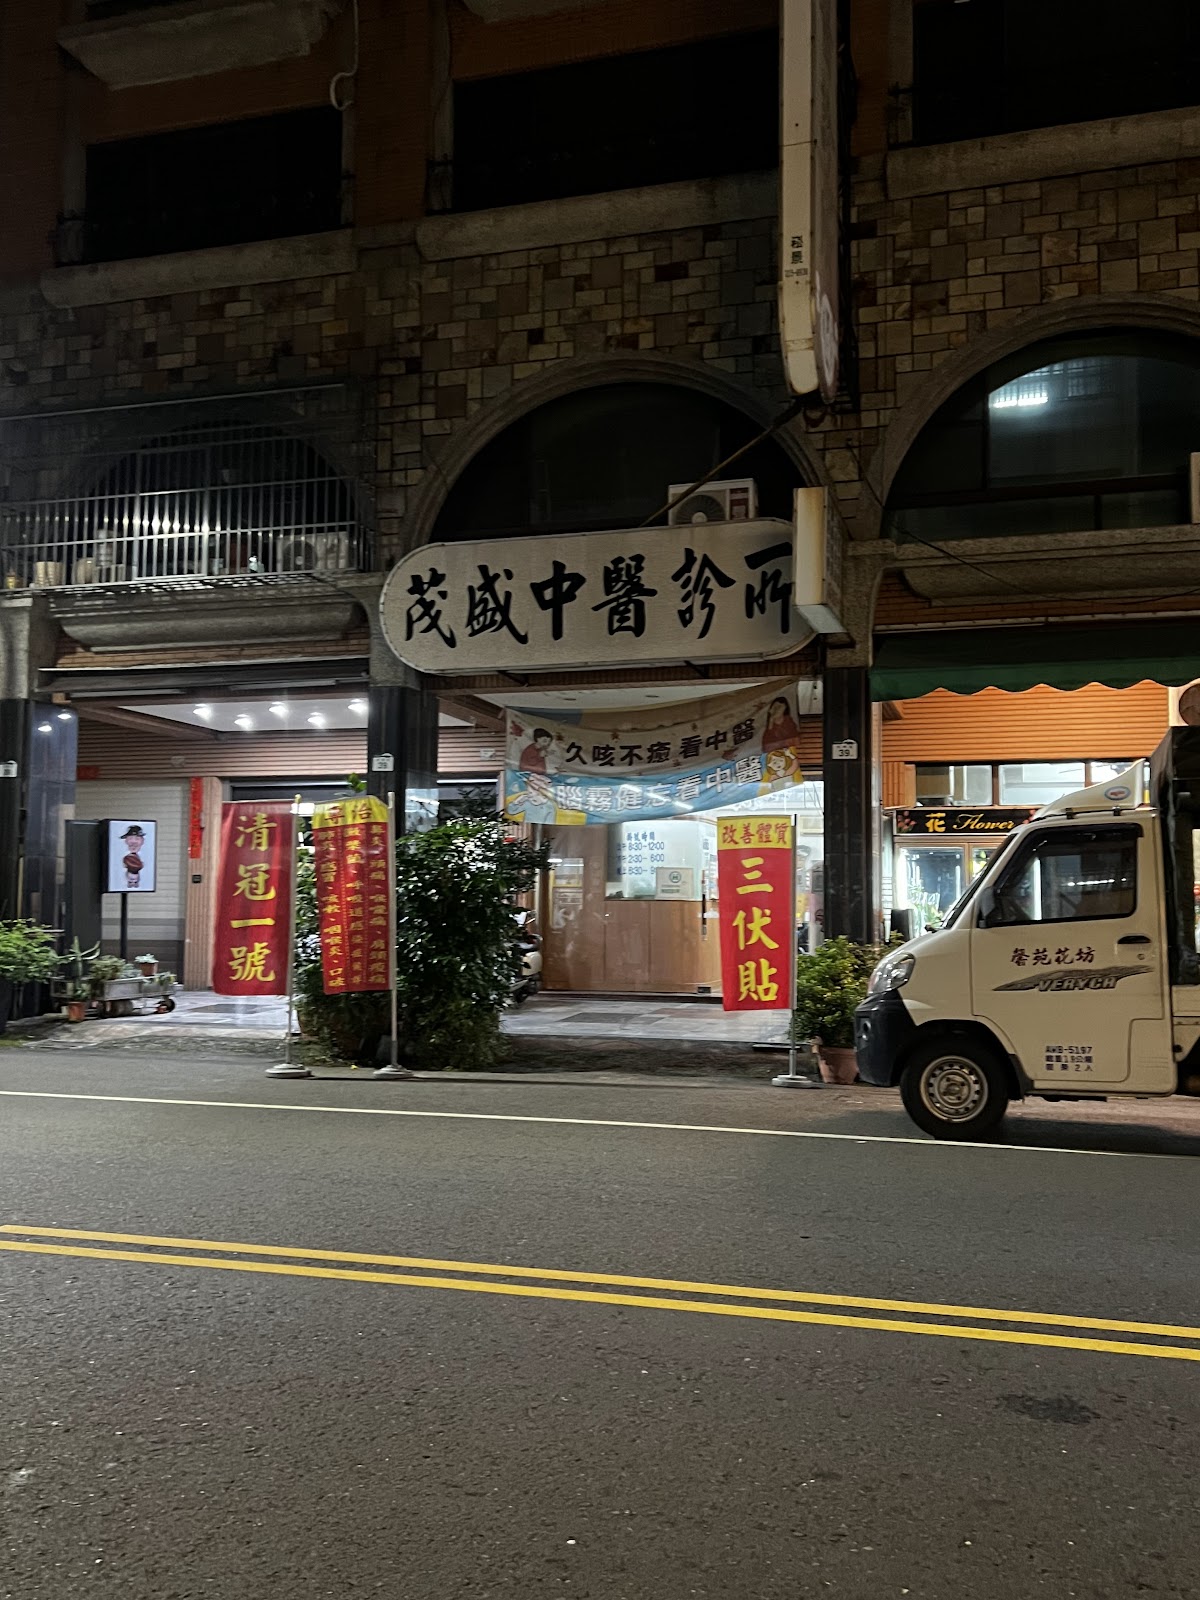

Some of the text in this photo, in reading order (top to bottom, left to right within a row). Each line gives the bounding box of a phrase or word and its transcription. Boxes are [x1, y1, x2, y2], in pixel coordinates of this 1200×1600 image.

[404, 542, 793, 649] 茂盛中醫診所
[564, 717, 755, 768] 久咳不癒看中醫
[554, 753, 763, 812] 腦霧健忘看中醫
[722, 823, 790, 845] 改善體質
[926, 812, 1015, 832] 花 Flower
[228, 812, 277, 983] 清冠一號
[732, 857, 780, 1002] 三伏貼
[1011, 947, 1096, 966] 馨苑花坊
